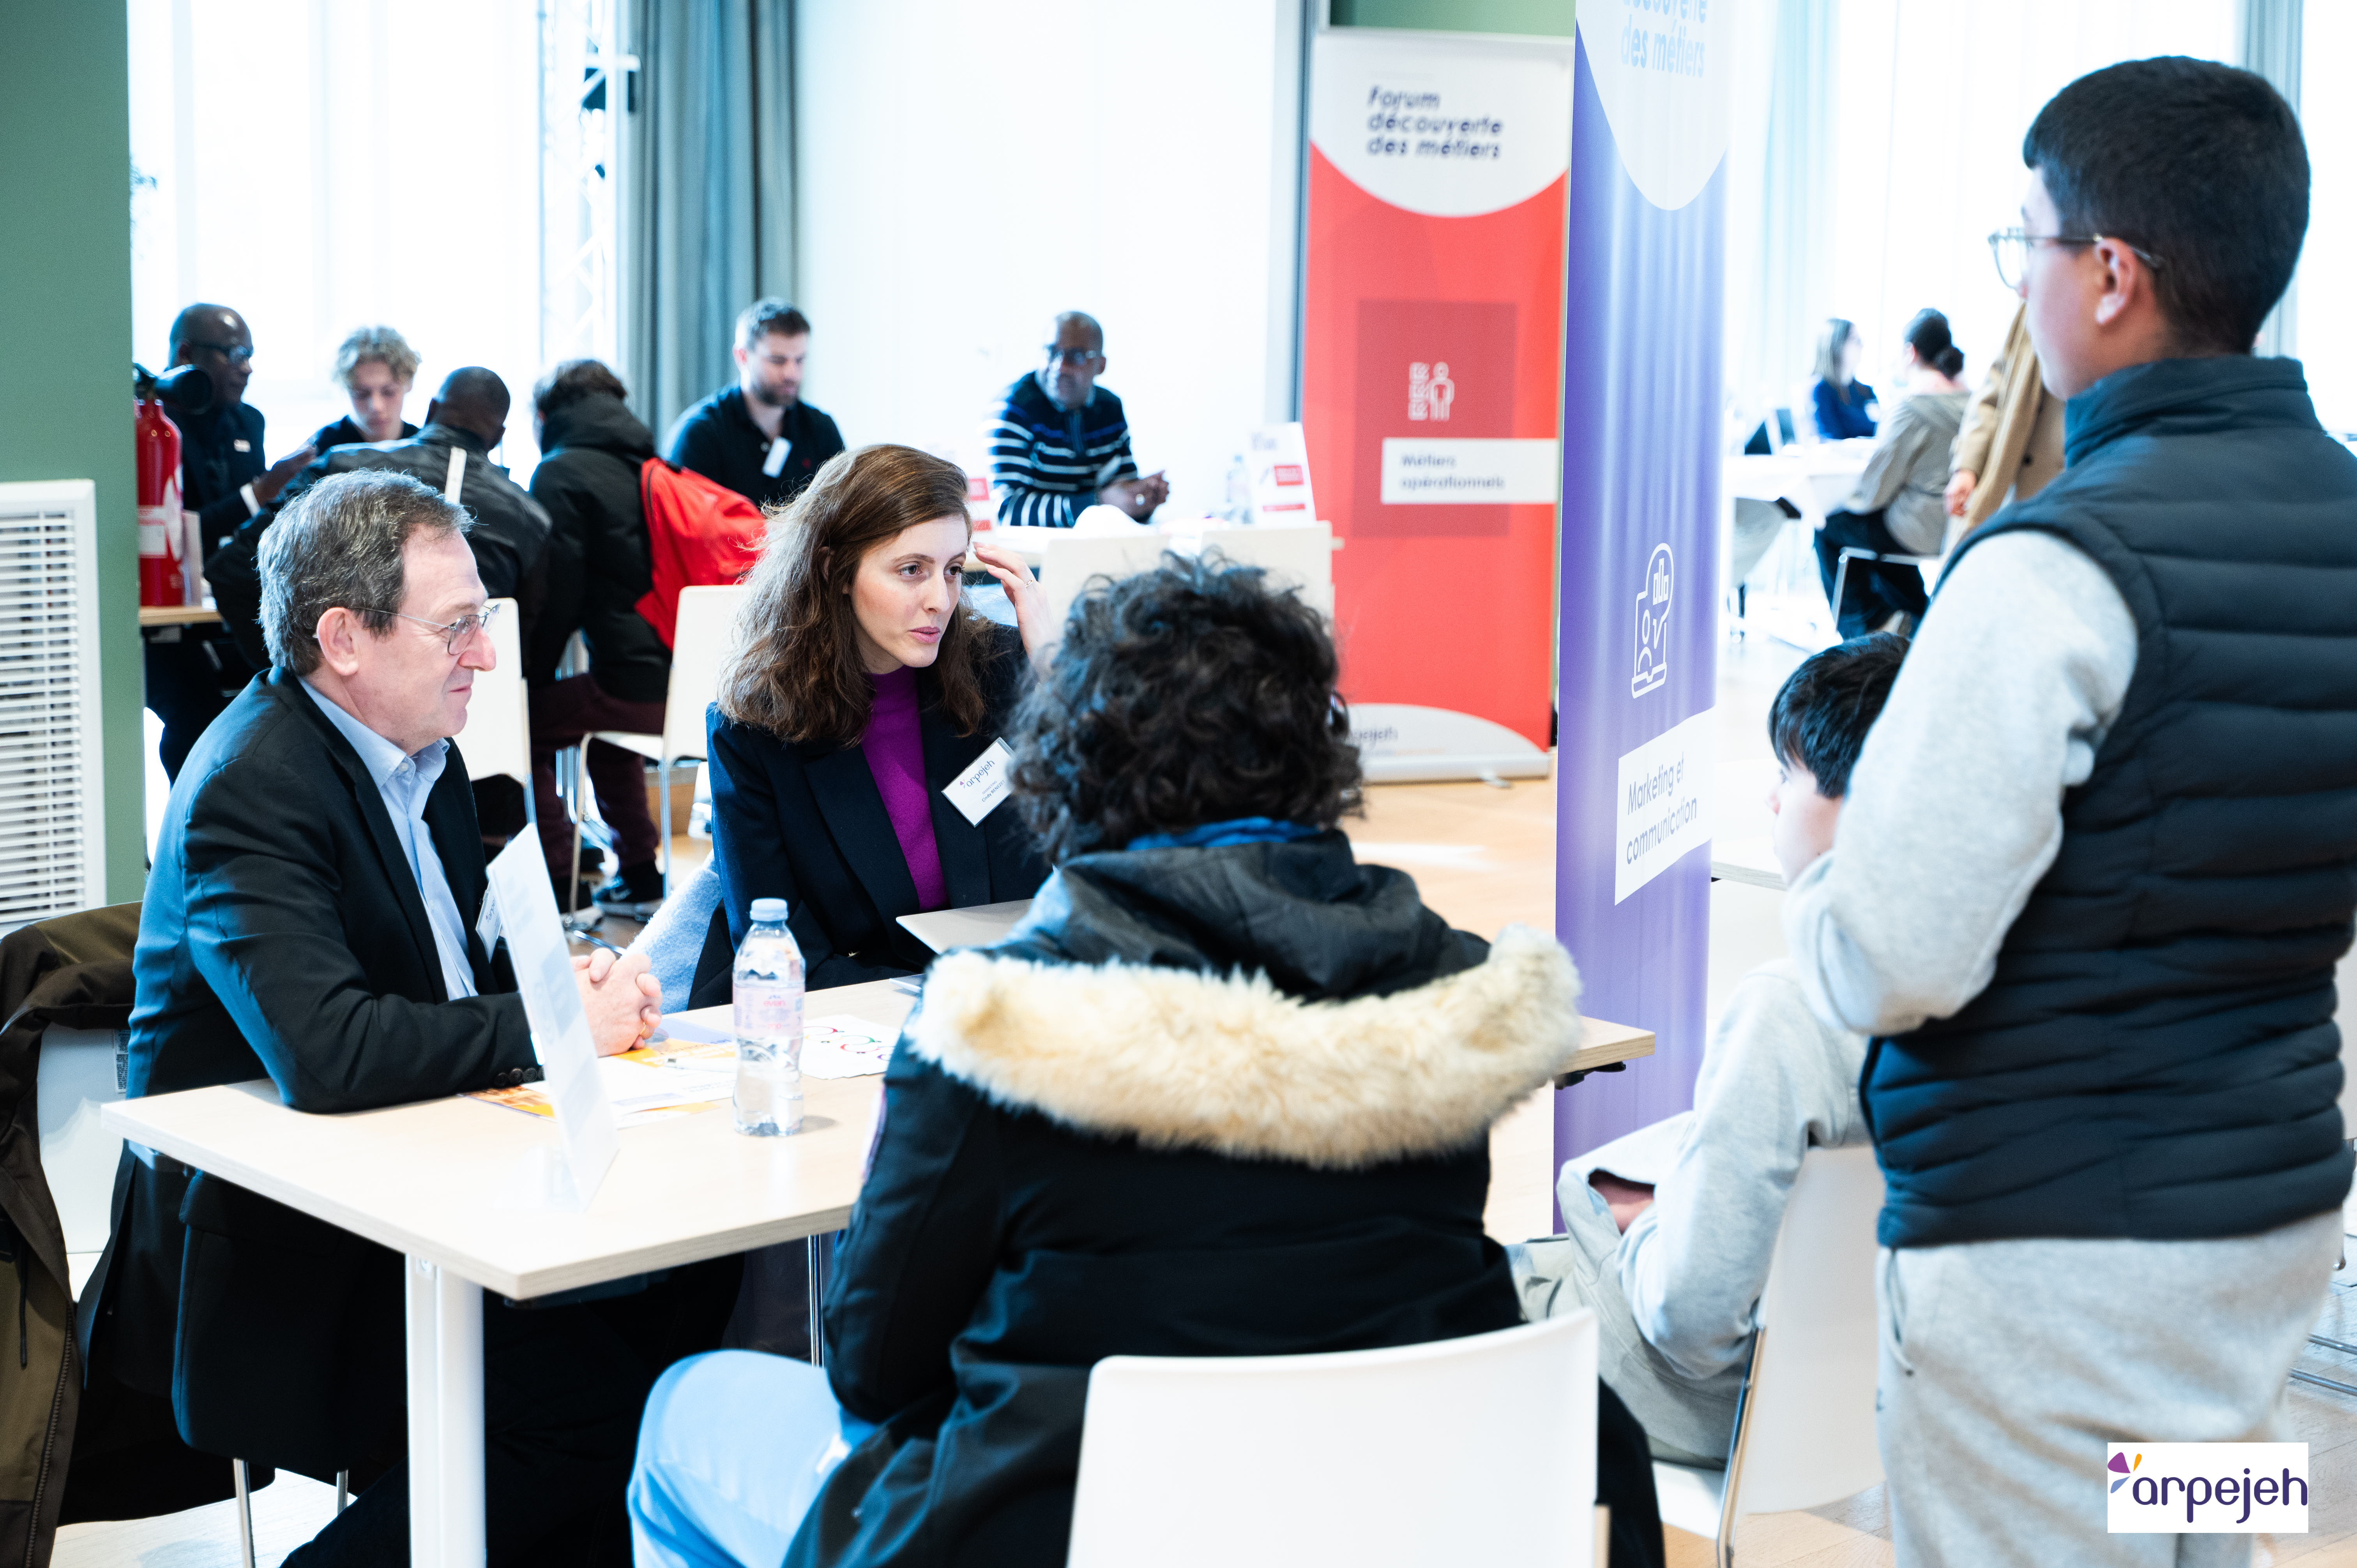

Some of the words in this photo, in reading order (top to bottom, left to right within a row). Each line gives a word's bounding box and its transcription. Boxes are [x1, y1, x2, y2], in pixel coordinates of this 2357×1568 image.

[1621, 14, 1648, 69] des
[1652, 19, 1705, 78] métiers
[1367, 85, 1441, 111] Forum
[1366, 135, 1408, 157] des
[966, 760, 995, 787] arpejeh
[1627, 764, 1674, 816] Marketing
[1677, 751, 1684, 784] et
[982, 780, 997, 795] MARKETING
[982, 793, 992, 802] Cindy
[991, 779, 1005, 794] BENEZET
[1627, 796, 1697, 865] communication
